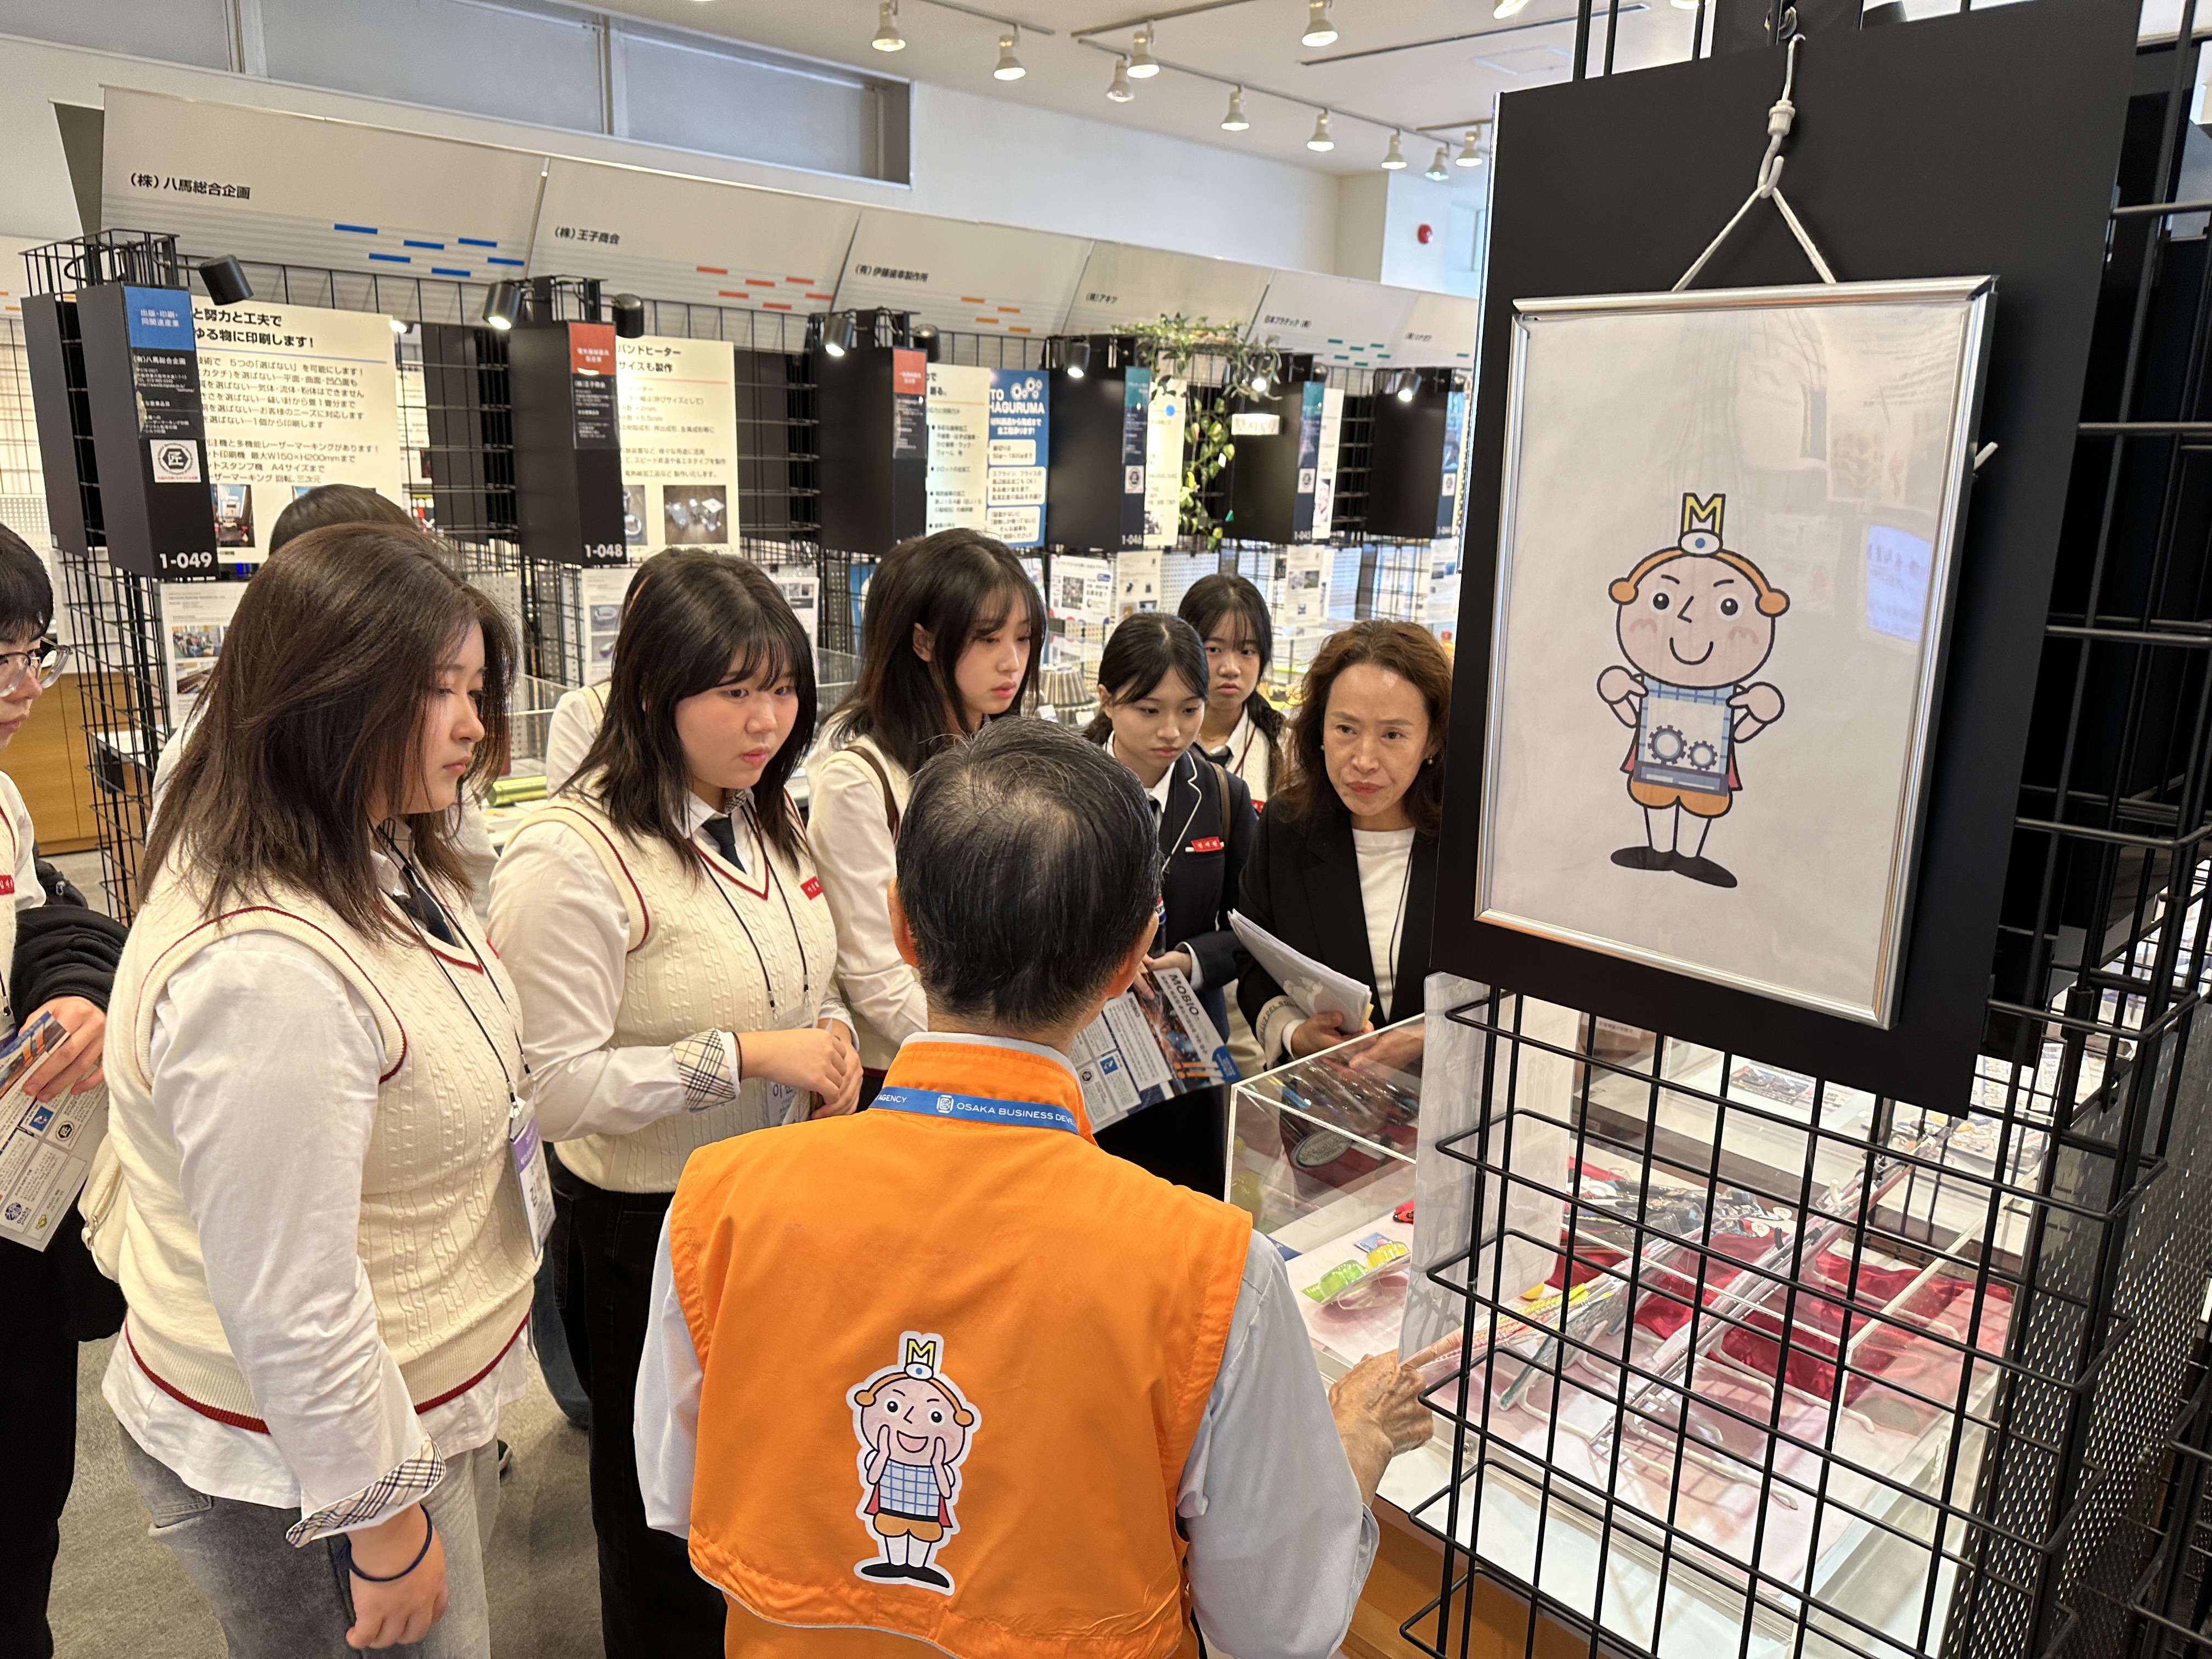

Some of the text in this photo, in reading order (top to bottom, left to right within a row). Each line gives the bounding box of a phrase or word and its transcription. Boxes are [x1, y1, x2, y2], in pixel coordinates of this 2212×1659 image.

[131, 173, 251, 199] (株)八馬総合企画
[555, 226, 619, 245] (株)王子商会
[193, 308, 281, 326] と努力と工夫で
[990, 401, 1045, 414] HAGURUMA
[1680, 492, 1726, 534] M
[160, 552, 213, 570] 1-049
[585, 544, 623, 558] 1-048
[1169, 974, 1199, 1015] MOBIO
[1128, 997, 1141, 1018] MOBIO
[878, 1094, 1076, 1127] AGENCY OSAKA BUSINESS DEVE
[906, 1338, 936, 1364] M
